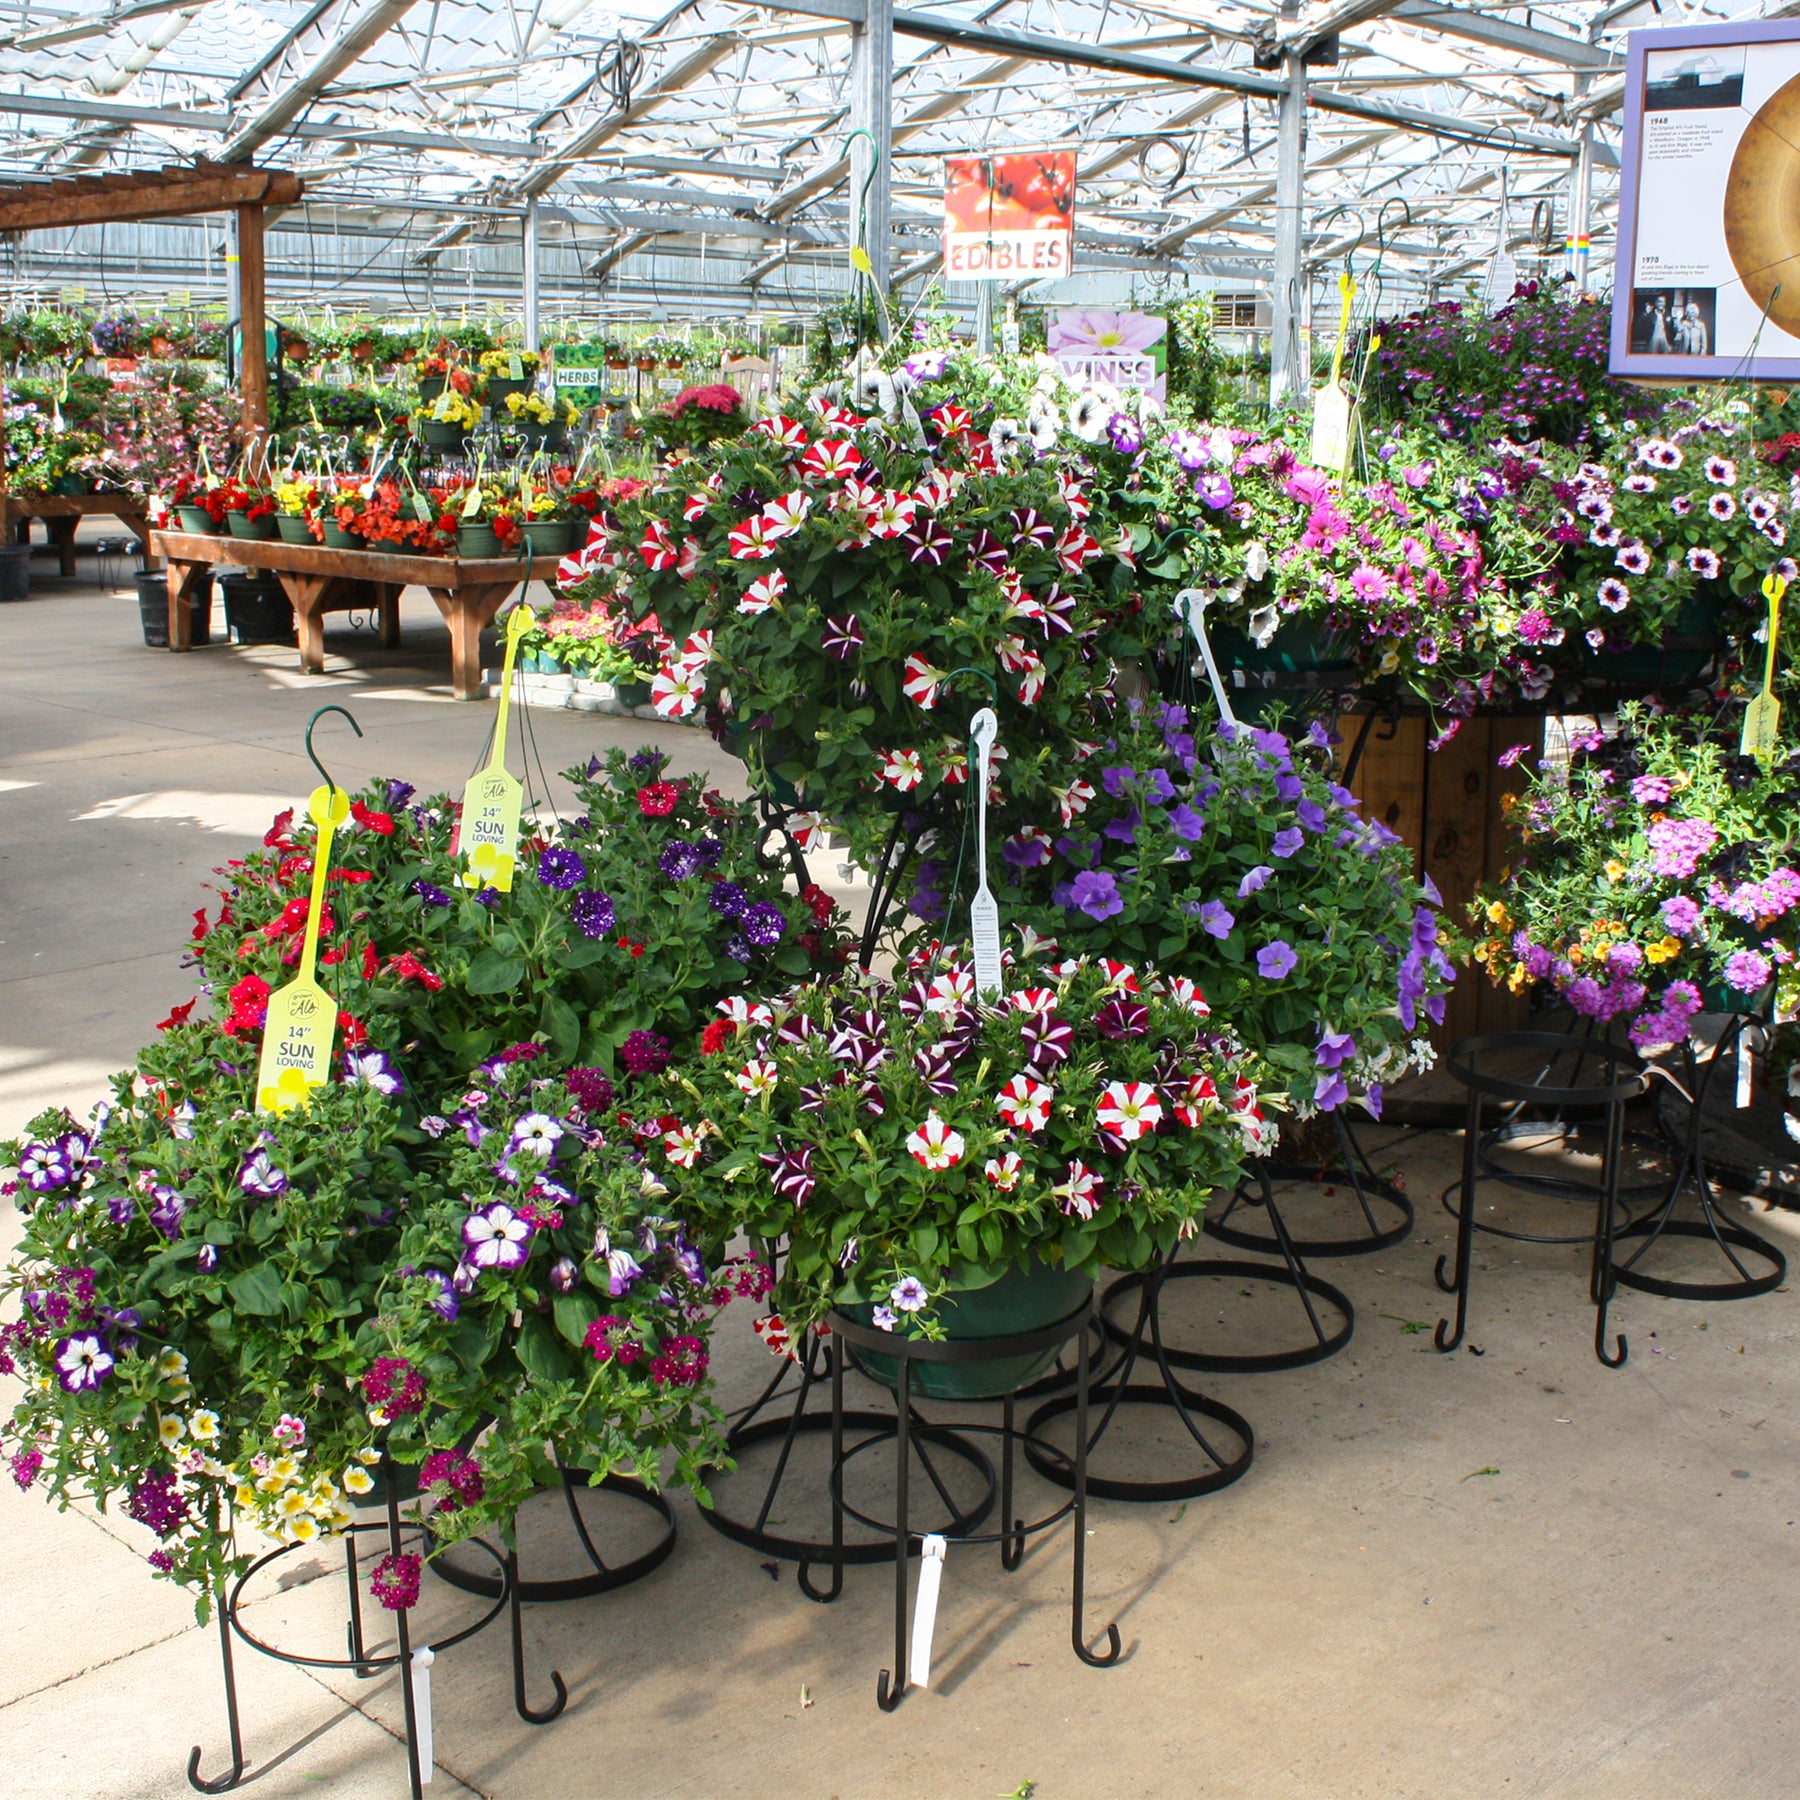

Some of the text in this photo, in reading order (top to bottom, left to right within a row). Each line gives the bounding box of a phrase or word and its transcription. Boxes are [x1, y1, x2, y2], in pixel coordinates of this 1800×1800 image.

[1650, 117, 1668, 125] 1948
[952, 241, 1062, 270] EDIBLES
[559, 371, 597, 383] HERBS
[1062, 361, 1151, 383] VINES
[474, 821, 504, 835] SUN
[472, 834, 504, 844] LOVING
[279, 1042, 314, 1058] SUN
[277, 1057, 314, 1069] LOVING
